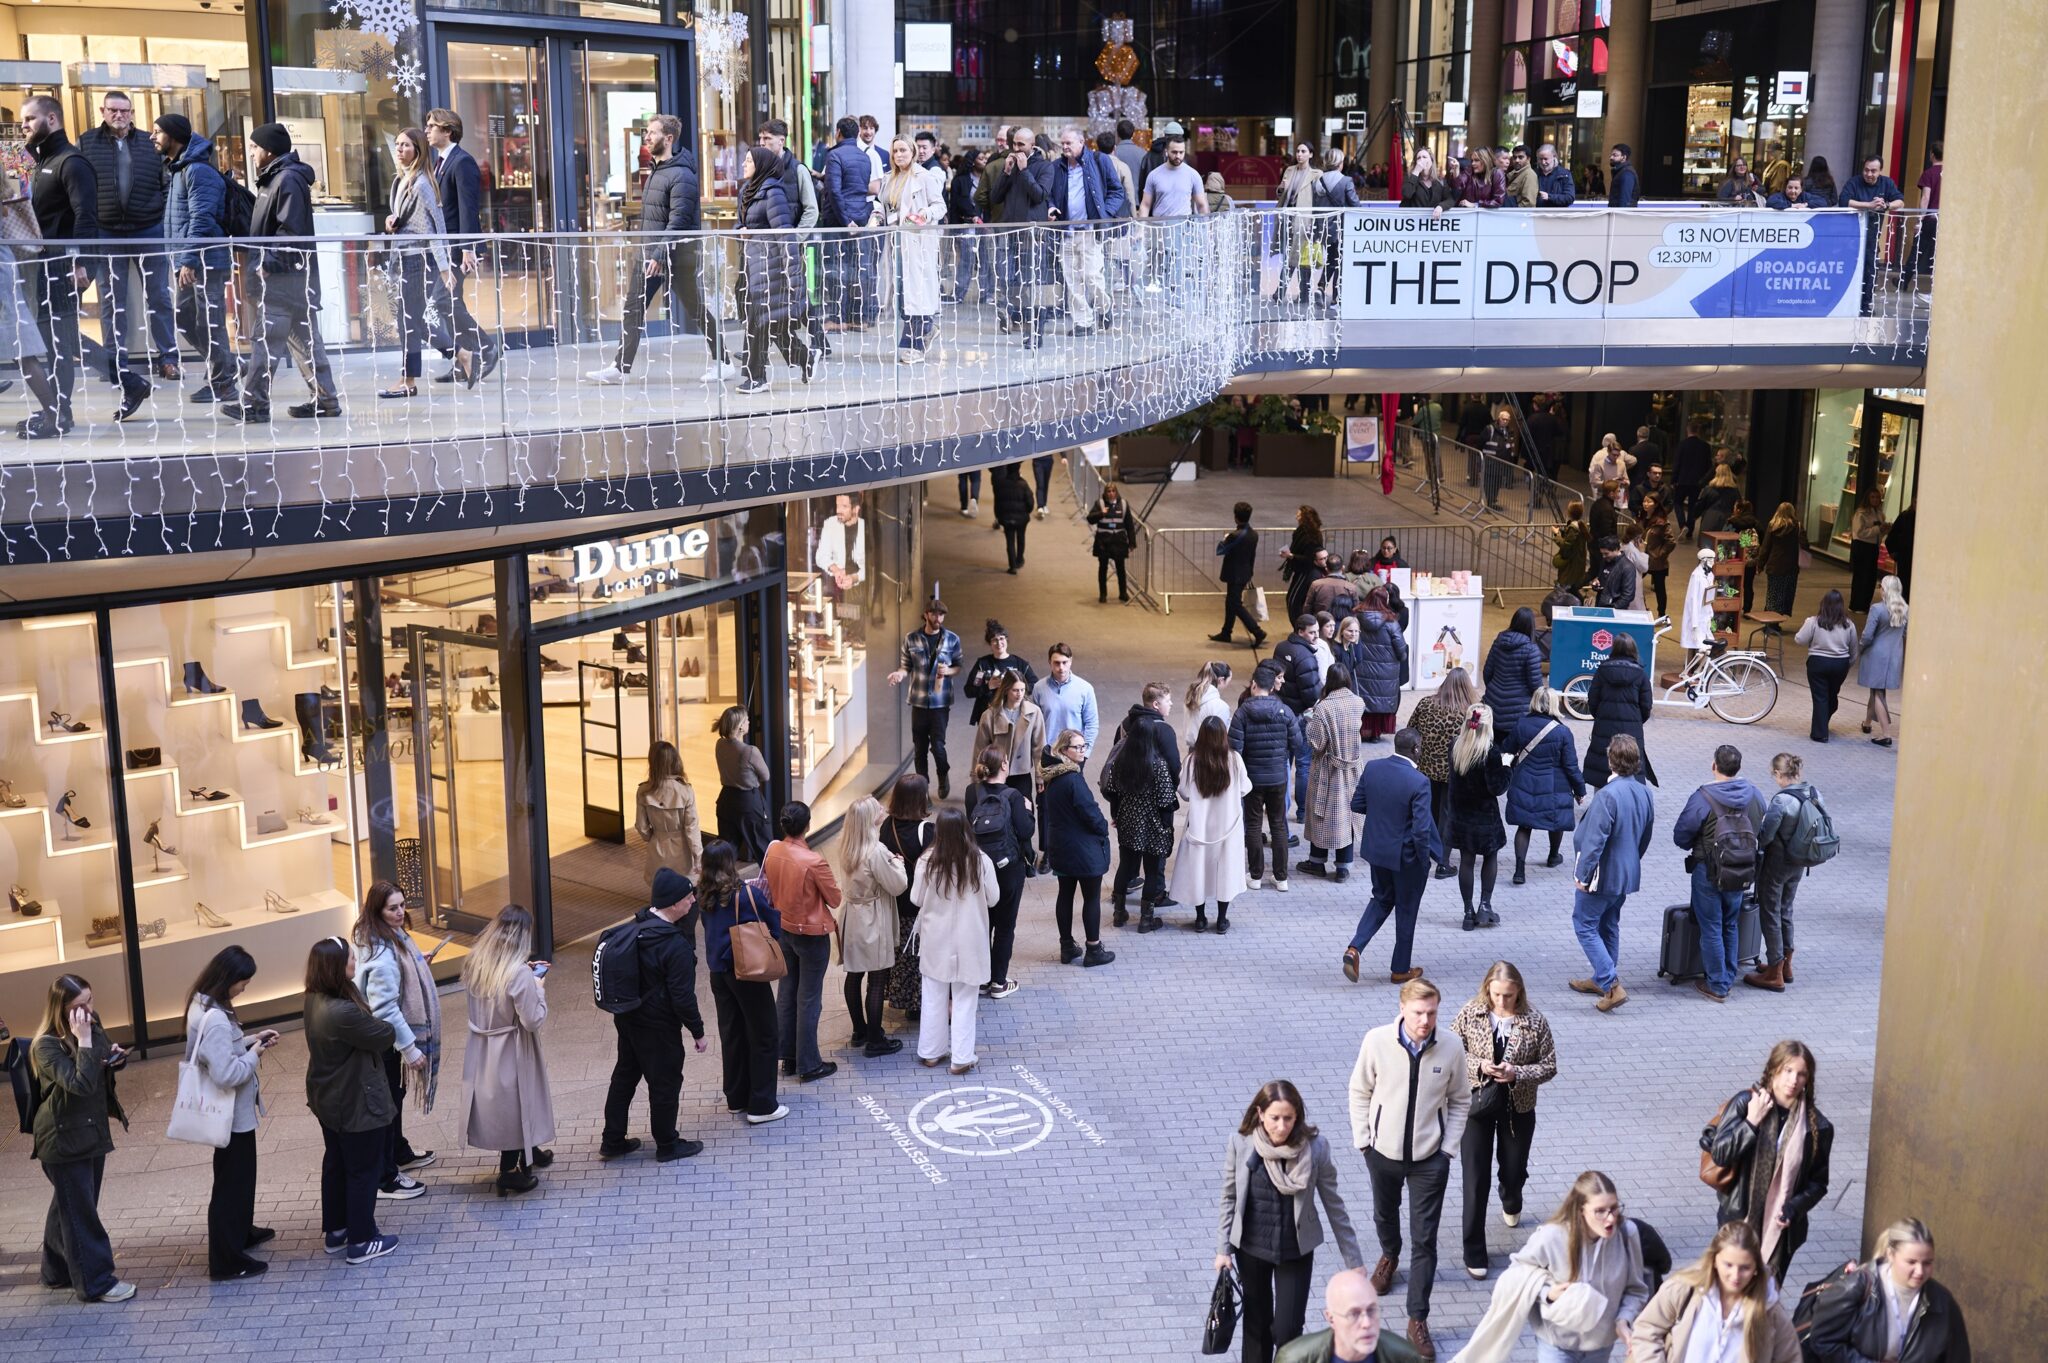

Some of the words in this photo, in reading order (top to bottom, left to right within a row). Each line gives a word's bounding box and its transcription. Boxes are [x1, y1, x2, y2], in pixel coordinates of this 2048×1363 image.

[1354, 218, 1391, 232] JOIN
[1394, 218, 1415, 232] US
[1419, 218, 1461, 232] HERE
[1678, 228, 1695, 243] 13
[1700, 228, 1800, 243] NOVEMBER
[1353, 239, 1418, 253] LAUNCH
[1421, 239, 1474, 253] EVENT
[1656, 251, 1712, 263] 12.30PM
[1754, 261, 1845, 275] BROADGATE
[1353, 261, 1462, 305] THE
[1484, 259, 1640, 305] DROP
[1765, 277, 1832, 291] CENTRAL
[573, 528, 710, 584] Dune
[604, 567, 679, 597] LONDON
[592, 941, 607, 1001] adidas
[1011, 1064, 1052, 1096] WHEELS
[857, 1094, 891, 1122] ZONE
[1047, 1096, 1077, 1120] YOUR
[1072, 1119, 1106, 1146] WALK
[881, 1122, 948, 1184] PEDESTRIAN
